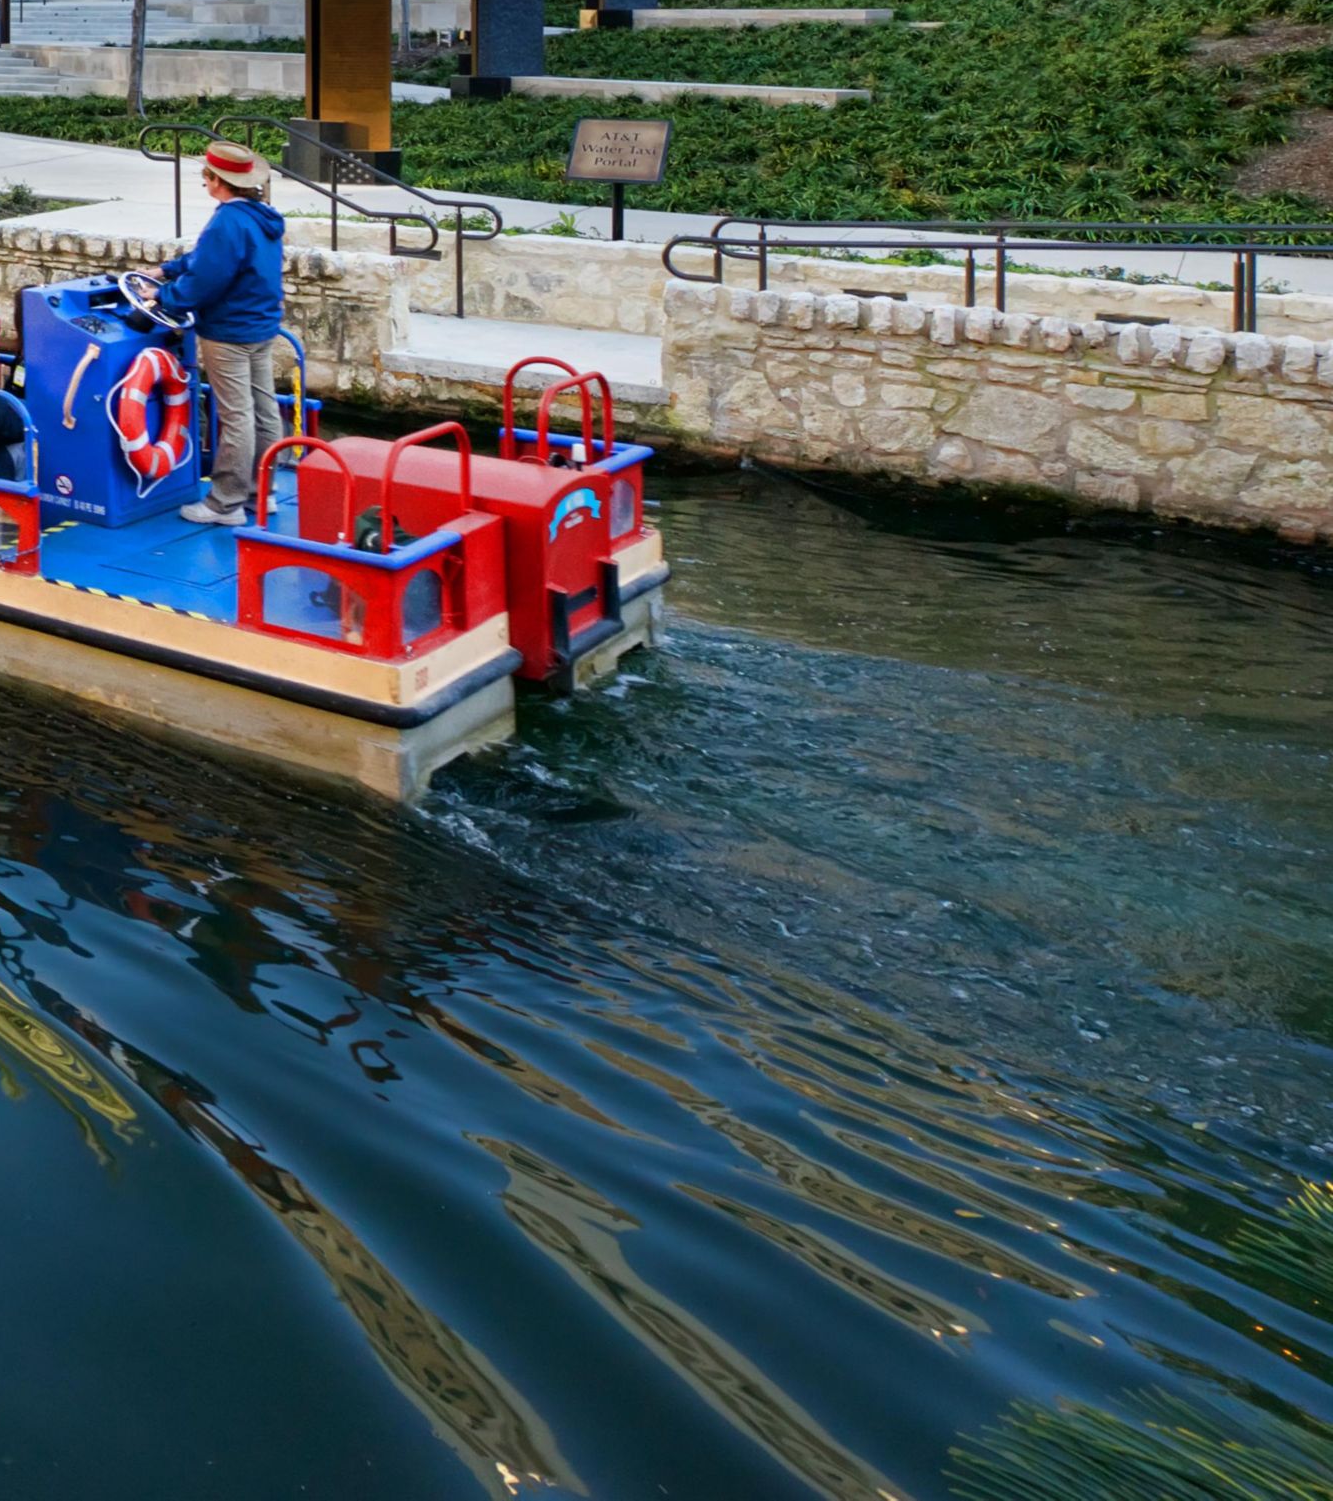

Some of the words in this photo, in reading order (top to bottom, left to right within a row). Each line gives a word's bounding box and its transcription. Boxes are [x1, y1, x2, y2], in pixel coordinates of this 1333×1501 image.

[600, 132, 642, 142] AT&T
[582, 144, 624, 155] Water
[628, 145, 658, 156] Taxi
[593, 156, 637, 168] Portal
